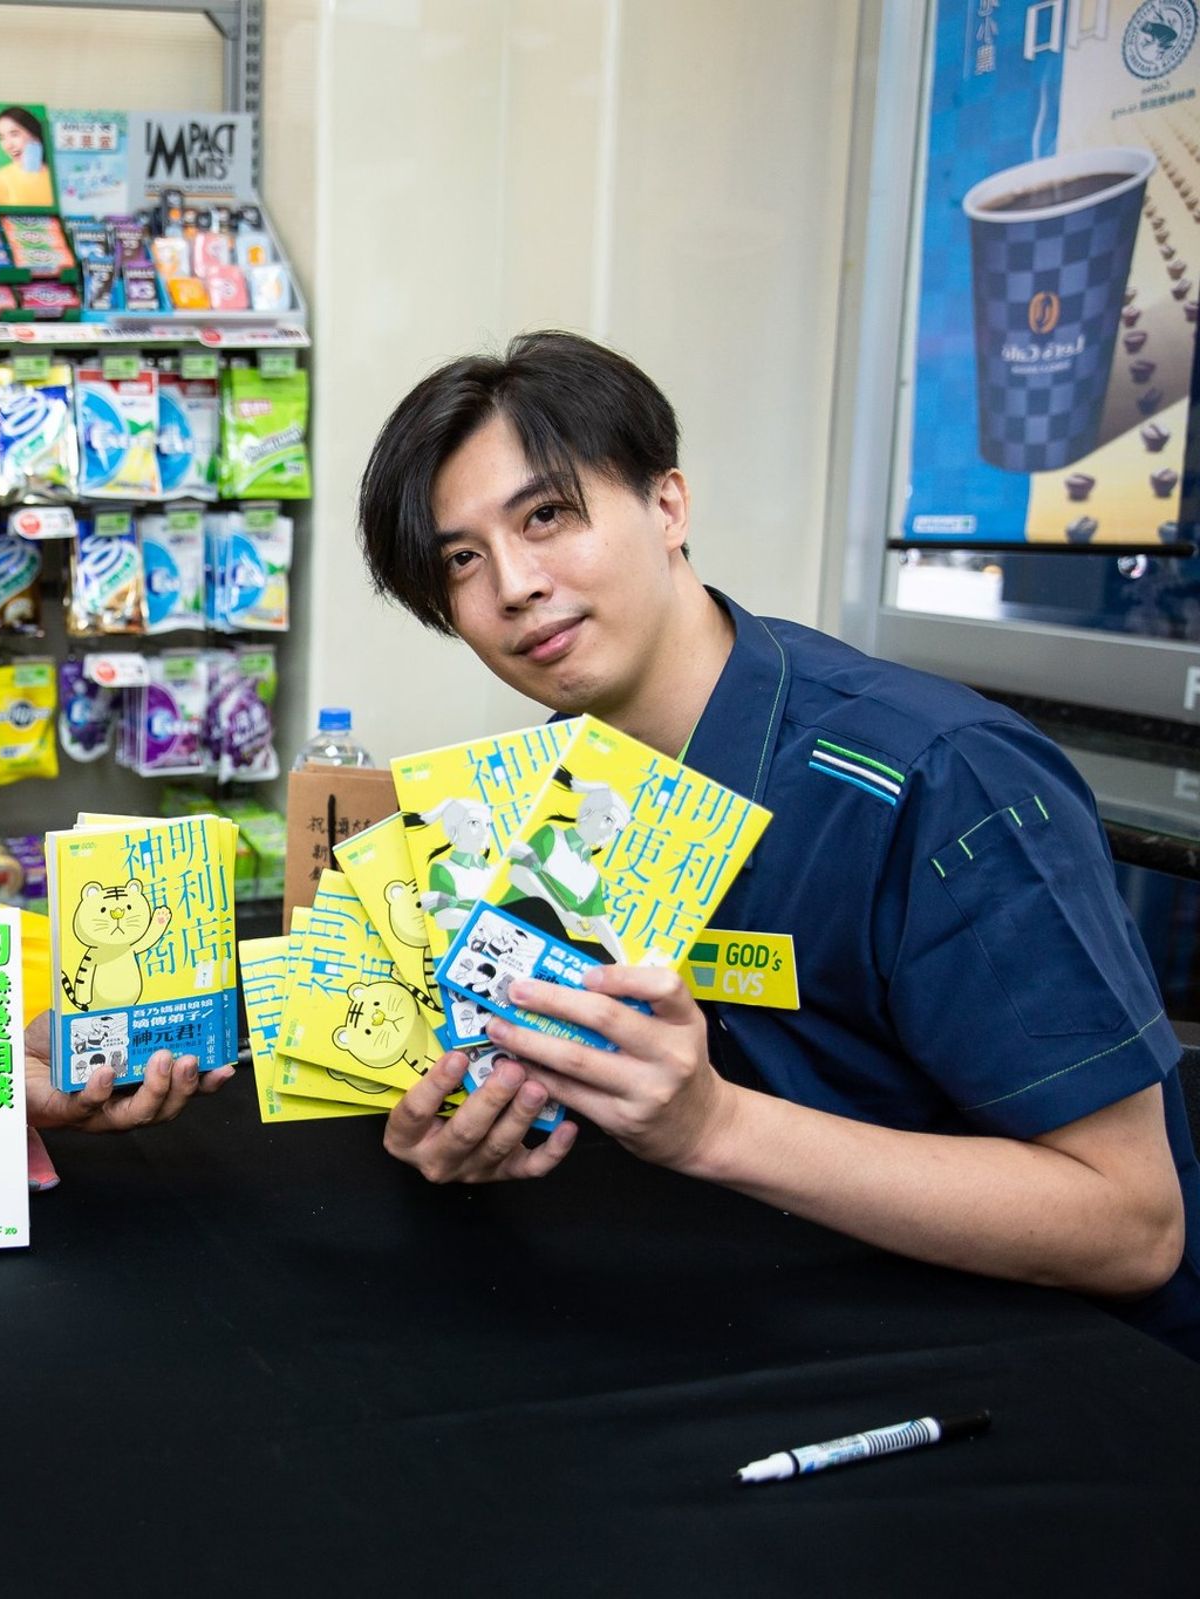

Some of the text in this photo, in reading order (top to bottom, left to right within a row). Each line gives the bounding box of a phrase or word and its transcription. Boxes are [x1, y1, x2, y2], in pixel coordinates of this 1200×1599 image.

[145, 119, 236, 165] IMPACT
[629, 757, 753, 850] 神明
[120, 819, 209, 879] 神明
[601, 822, 730, 906] 便利
[135, 917, 219, 978] 商店
[601, 876, 705, 960] 商店
[722, 969, 766, 997] CVS
[725, 942, 783, 971] GOD's
